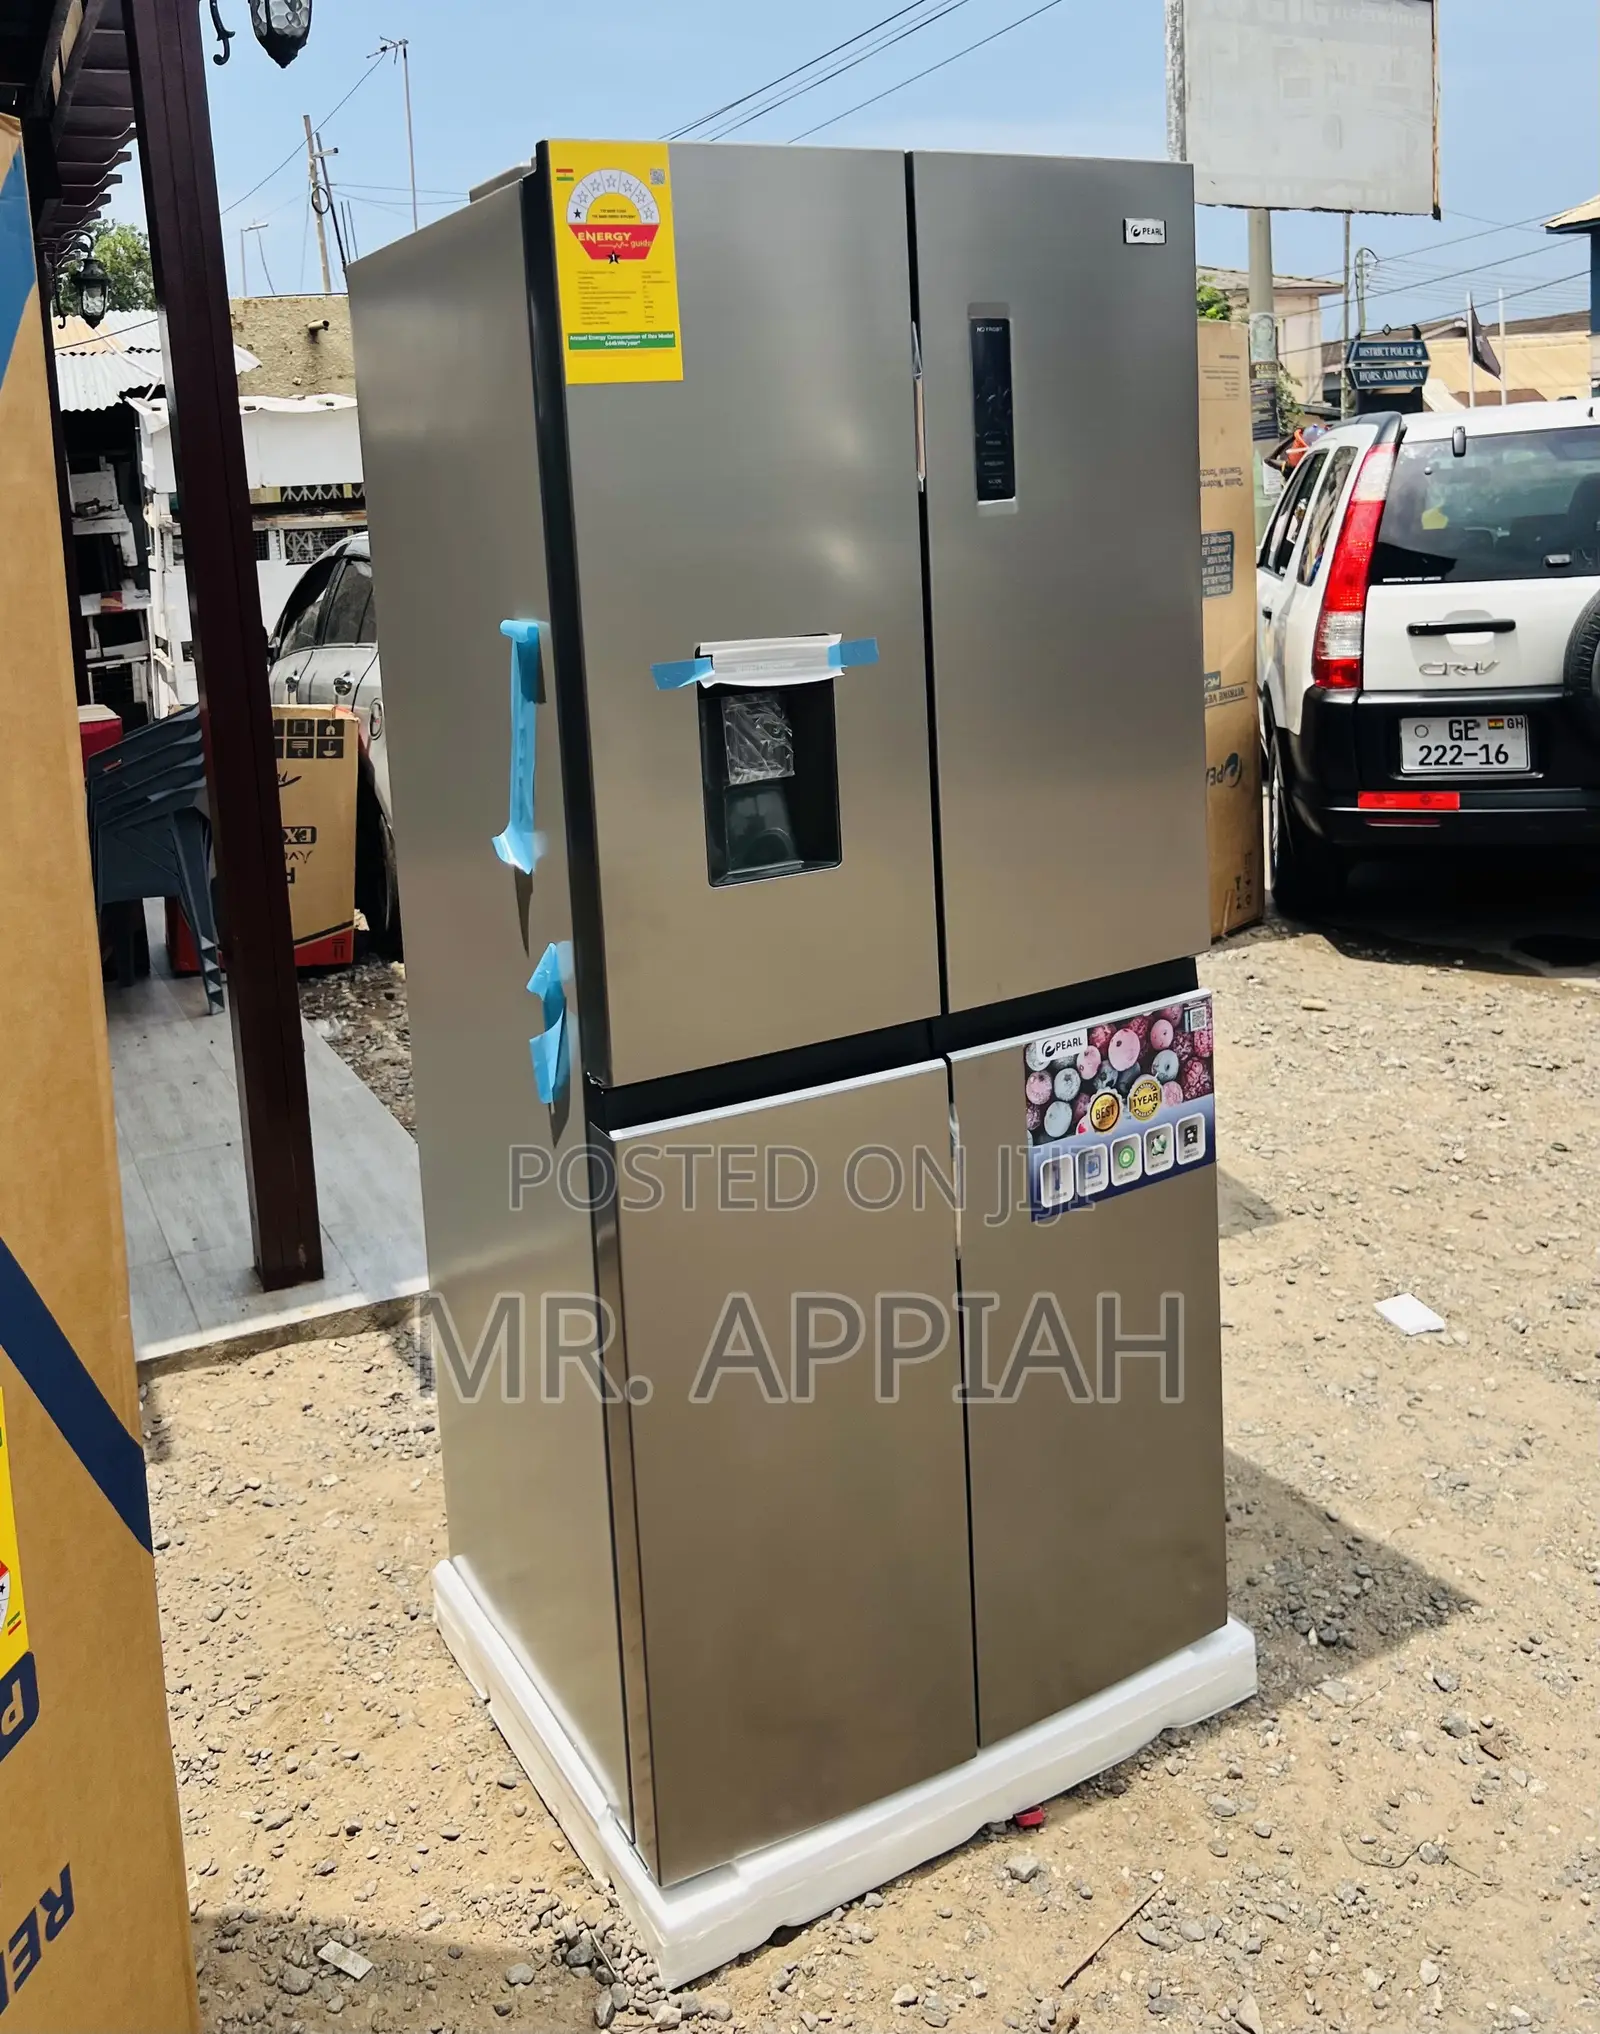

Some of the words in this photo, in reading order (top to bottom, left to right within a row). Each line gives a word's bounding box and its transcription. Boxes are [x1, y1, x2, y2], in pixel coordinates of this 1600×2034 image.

[577, 231, 632, 244] ENERGY
[1142, 227, 1163, 236] PEARL
[630, 238, 652, 248] guide
[1358, 346, 1389, 357] DISTRICT
[1390, 345, 1415, 356] POLICE
[1383, 369, 1424, 381] ADABRAKA
[1448, 719, 1479, 741] GE
[1507, 717, 1524, 730] GH
[1418, 744, 1509, 766] 222-16
[1055, 1036, 1083, 1052] PEARL
[1137, 1093, 1159, 1107] YEAR
[1095, 1104, 1116, 1121] BEST
[0, 1862, 76, 2016] RE
